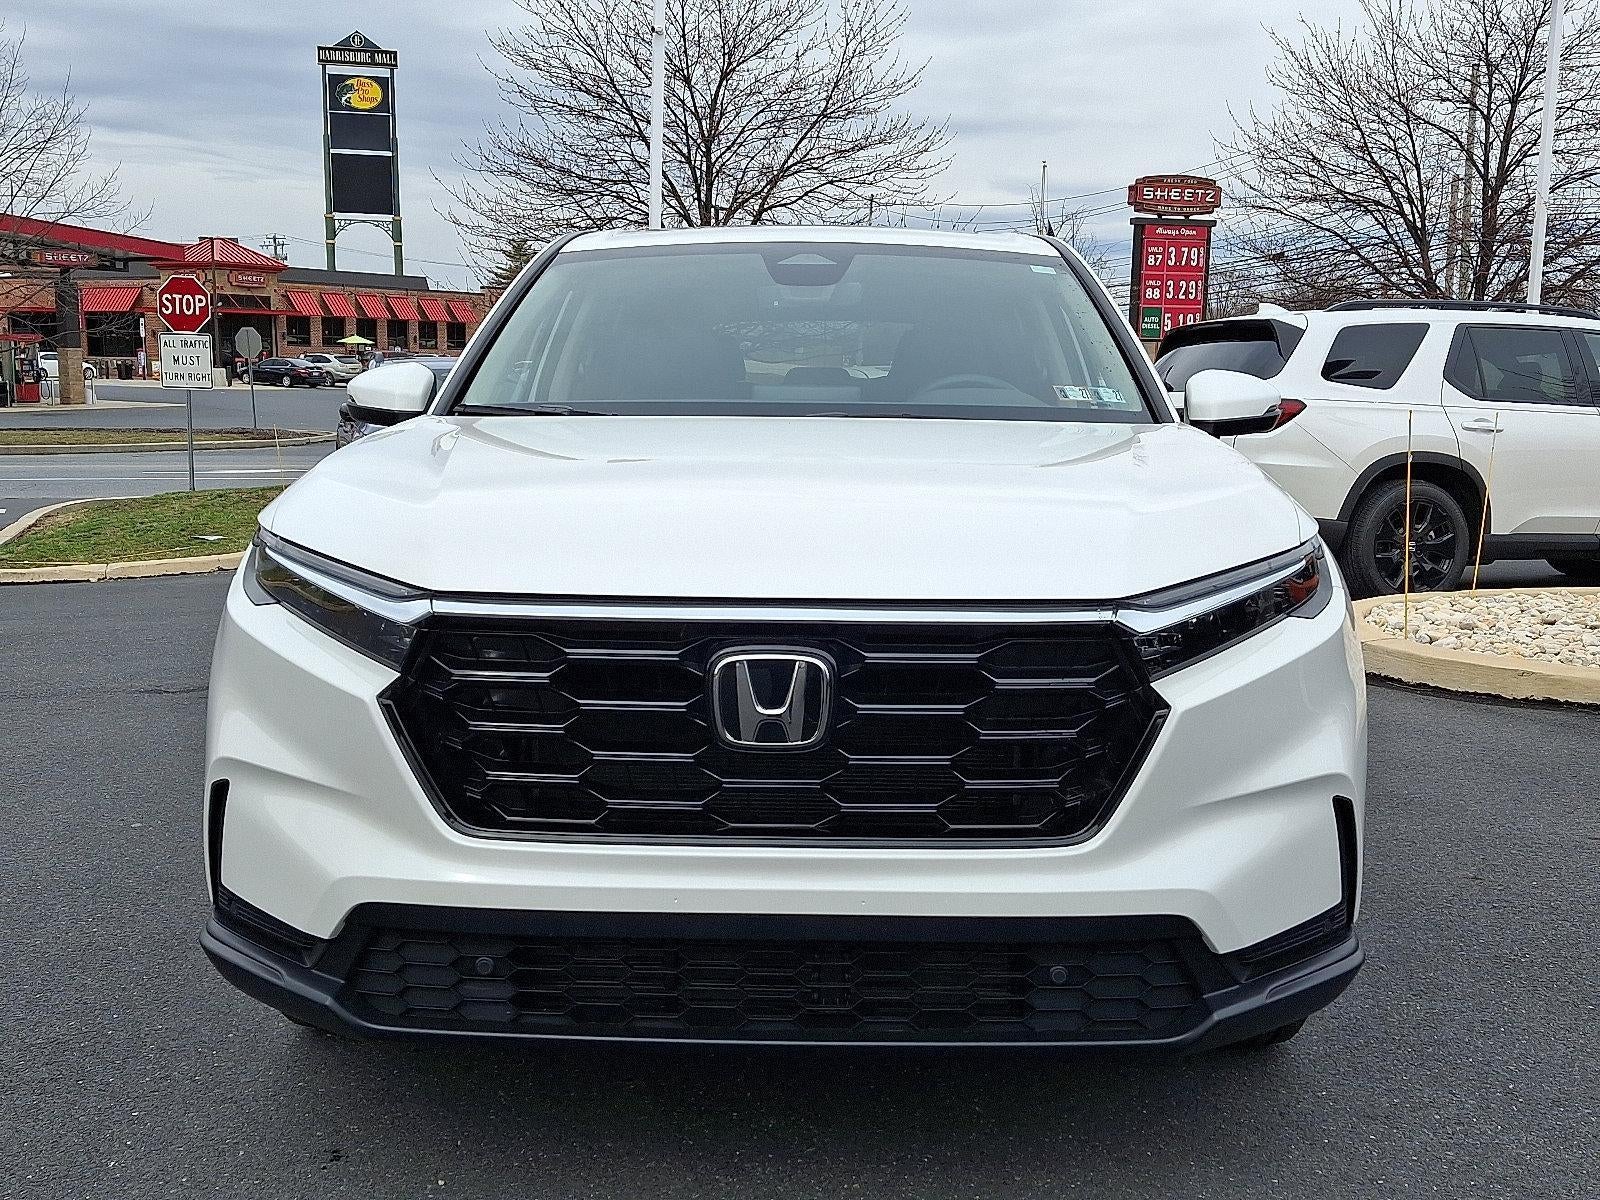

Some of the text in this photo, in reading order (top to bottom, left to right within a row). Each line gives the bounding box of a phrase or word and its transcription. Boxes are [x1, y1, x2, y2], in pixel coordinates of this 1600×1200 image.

[320, 49, 396, 64] HARRISBURG MALL
[357, 94, 378, 104] Shops
[1143, 187, 1216, 202] SHEETZ
[1156, 227, 1197, 236] Always Open
[45, 252, 90, 262] SHEETZ
[1147, 254, 1163, 266] 87
[237, 274, 264, 282] SHEETZ
[1145, 288, 1160, 299] 88
[161, 293, 207, 316] STOP
[163, 339, 209, 349] ALL TRAFFIC
[172, 355, 201, 366] MUST
[164, 372, 211, 382] TURN RIGHT
